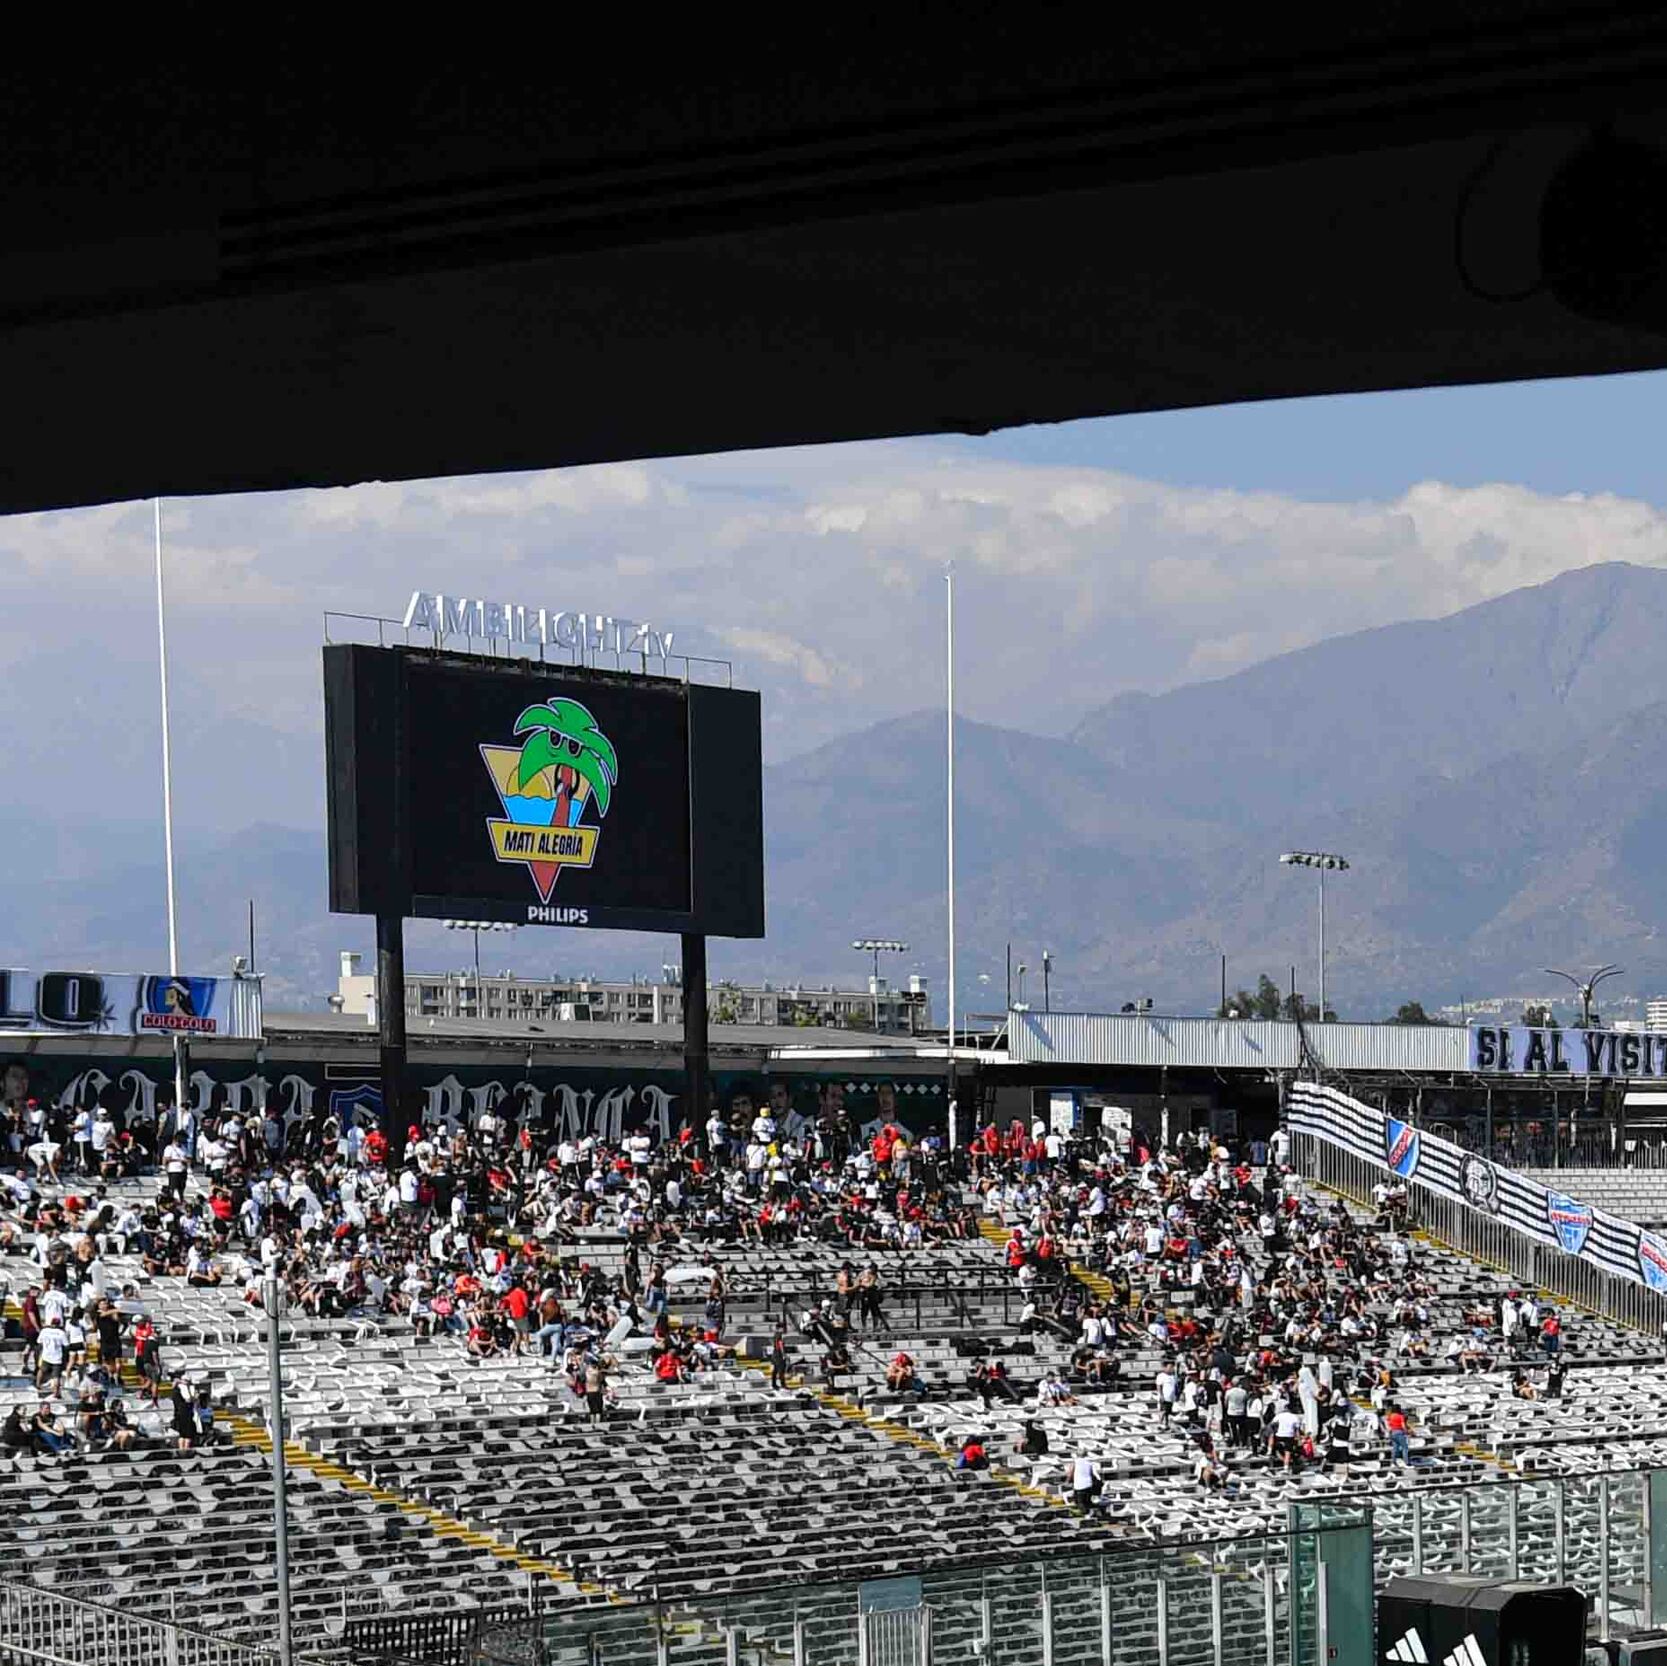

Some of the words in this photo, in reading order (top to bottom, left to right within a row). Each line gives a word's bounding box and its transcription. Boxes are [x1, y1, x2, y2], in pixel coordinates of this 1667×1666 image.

[504, 830, 535, 853] MATI
[538, 832, 583, 857] ALEGRÍA
[528, 906, 588, 923] PHILIPS
[1477, 1026, 1513, 1071] SI
[1524, 1028, 1570, 1072] AL
